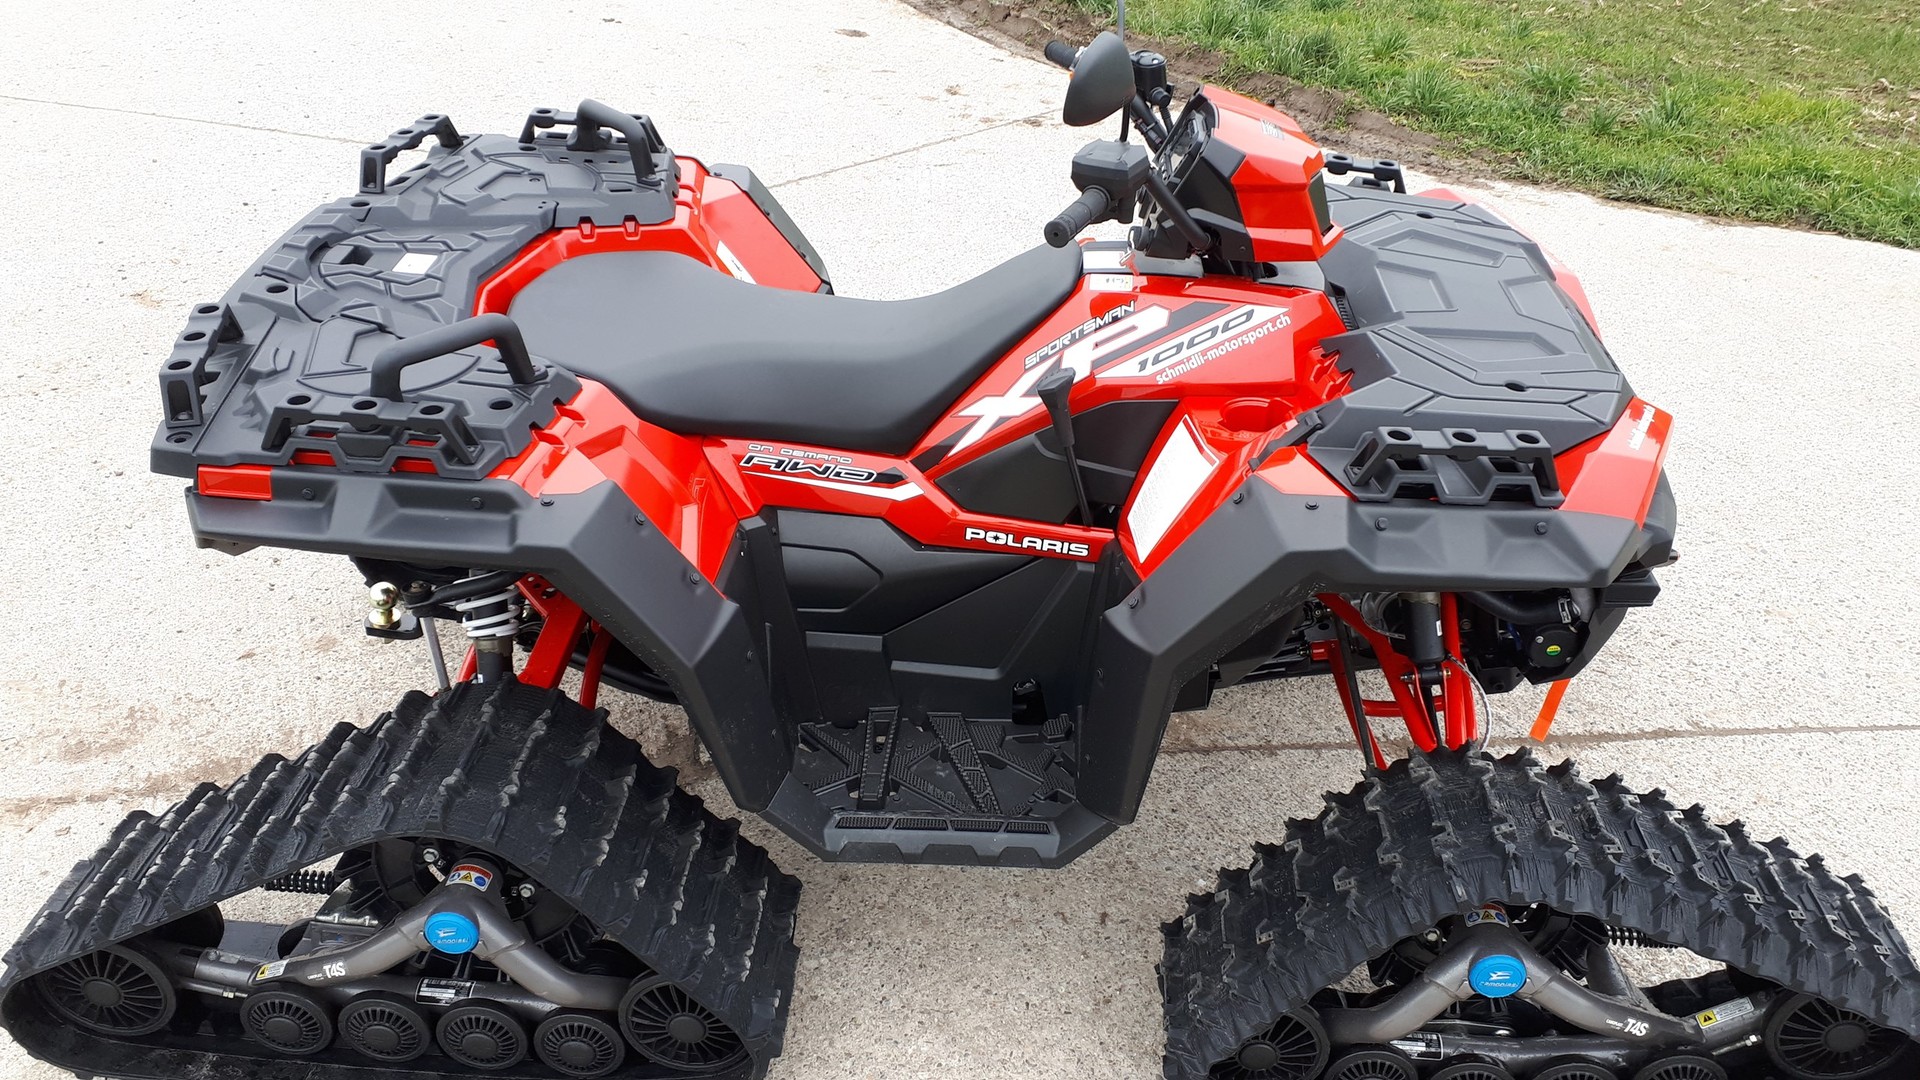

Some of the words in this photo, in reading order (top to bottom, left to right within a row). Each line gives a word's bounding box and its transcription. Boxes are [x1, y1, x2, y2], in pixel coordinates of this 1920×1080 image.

[1024, 300, 1136, 370] SPORTSMAN
[1137, 308, 1256, 373] 1000
[1156, 314, 1292, 385] schmidli-motorsport.ch
[739, 452, 877, 483] AWD
[779, 447, 853, 464] DEMAND
[964, 526, 1090, 557] POLARIS
[323, 961, 346, 979] T4S
[1624, 1017, 1651, 1037] T4S
